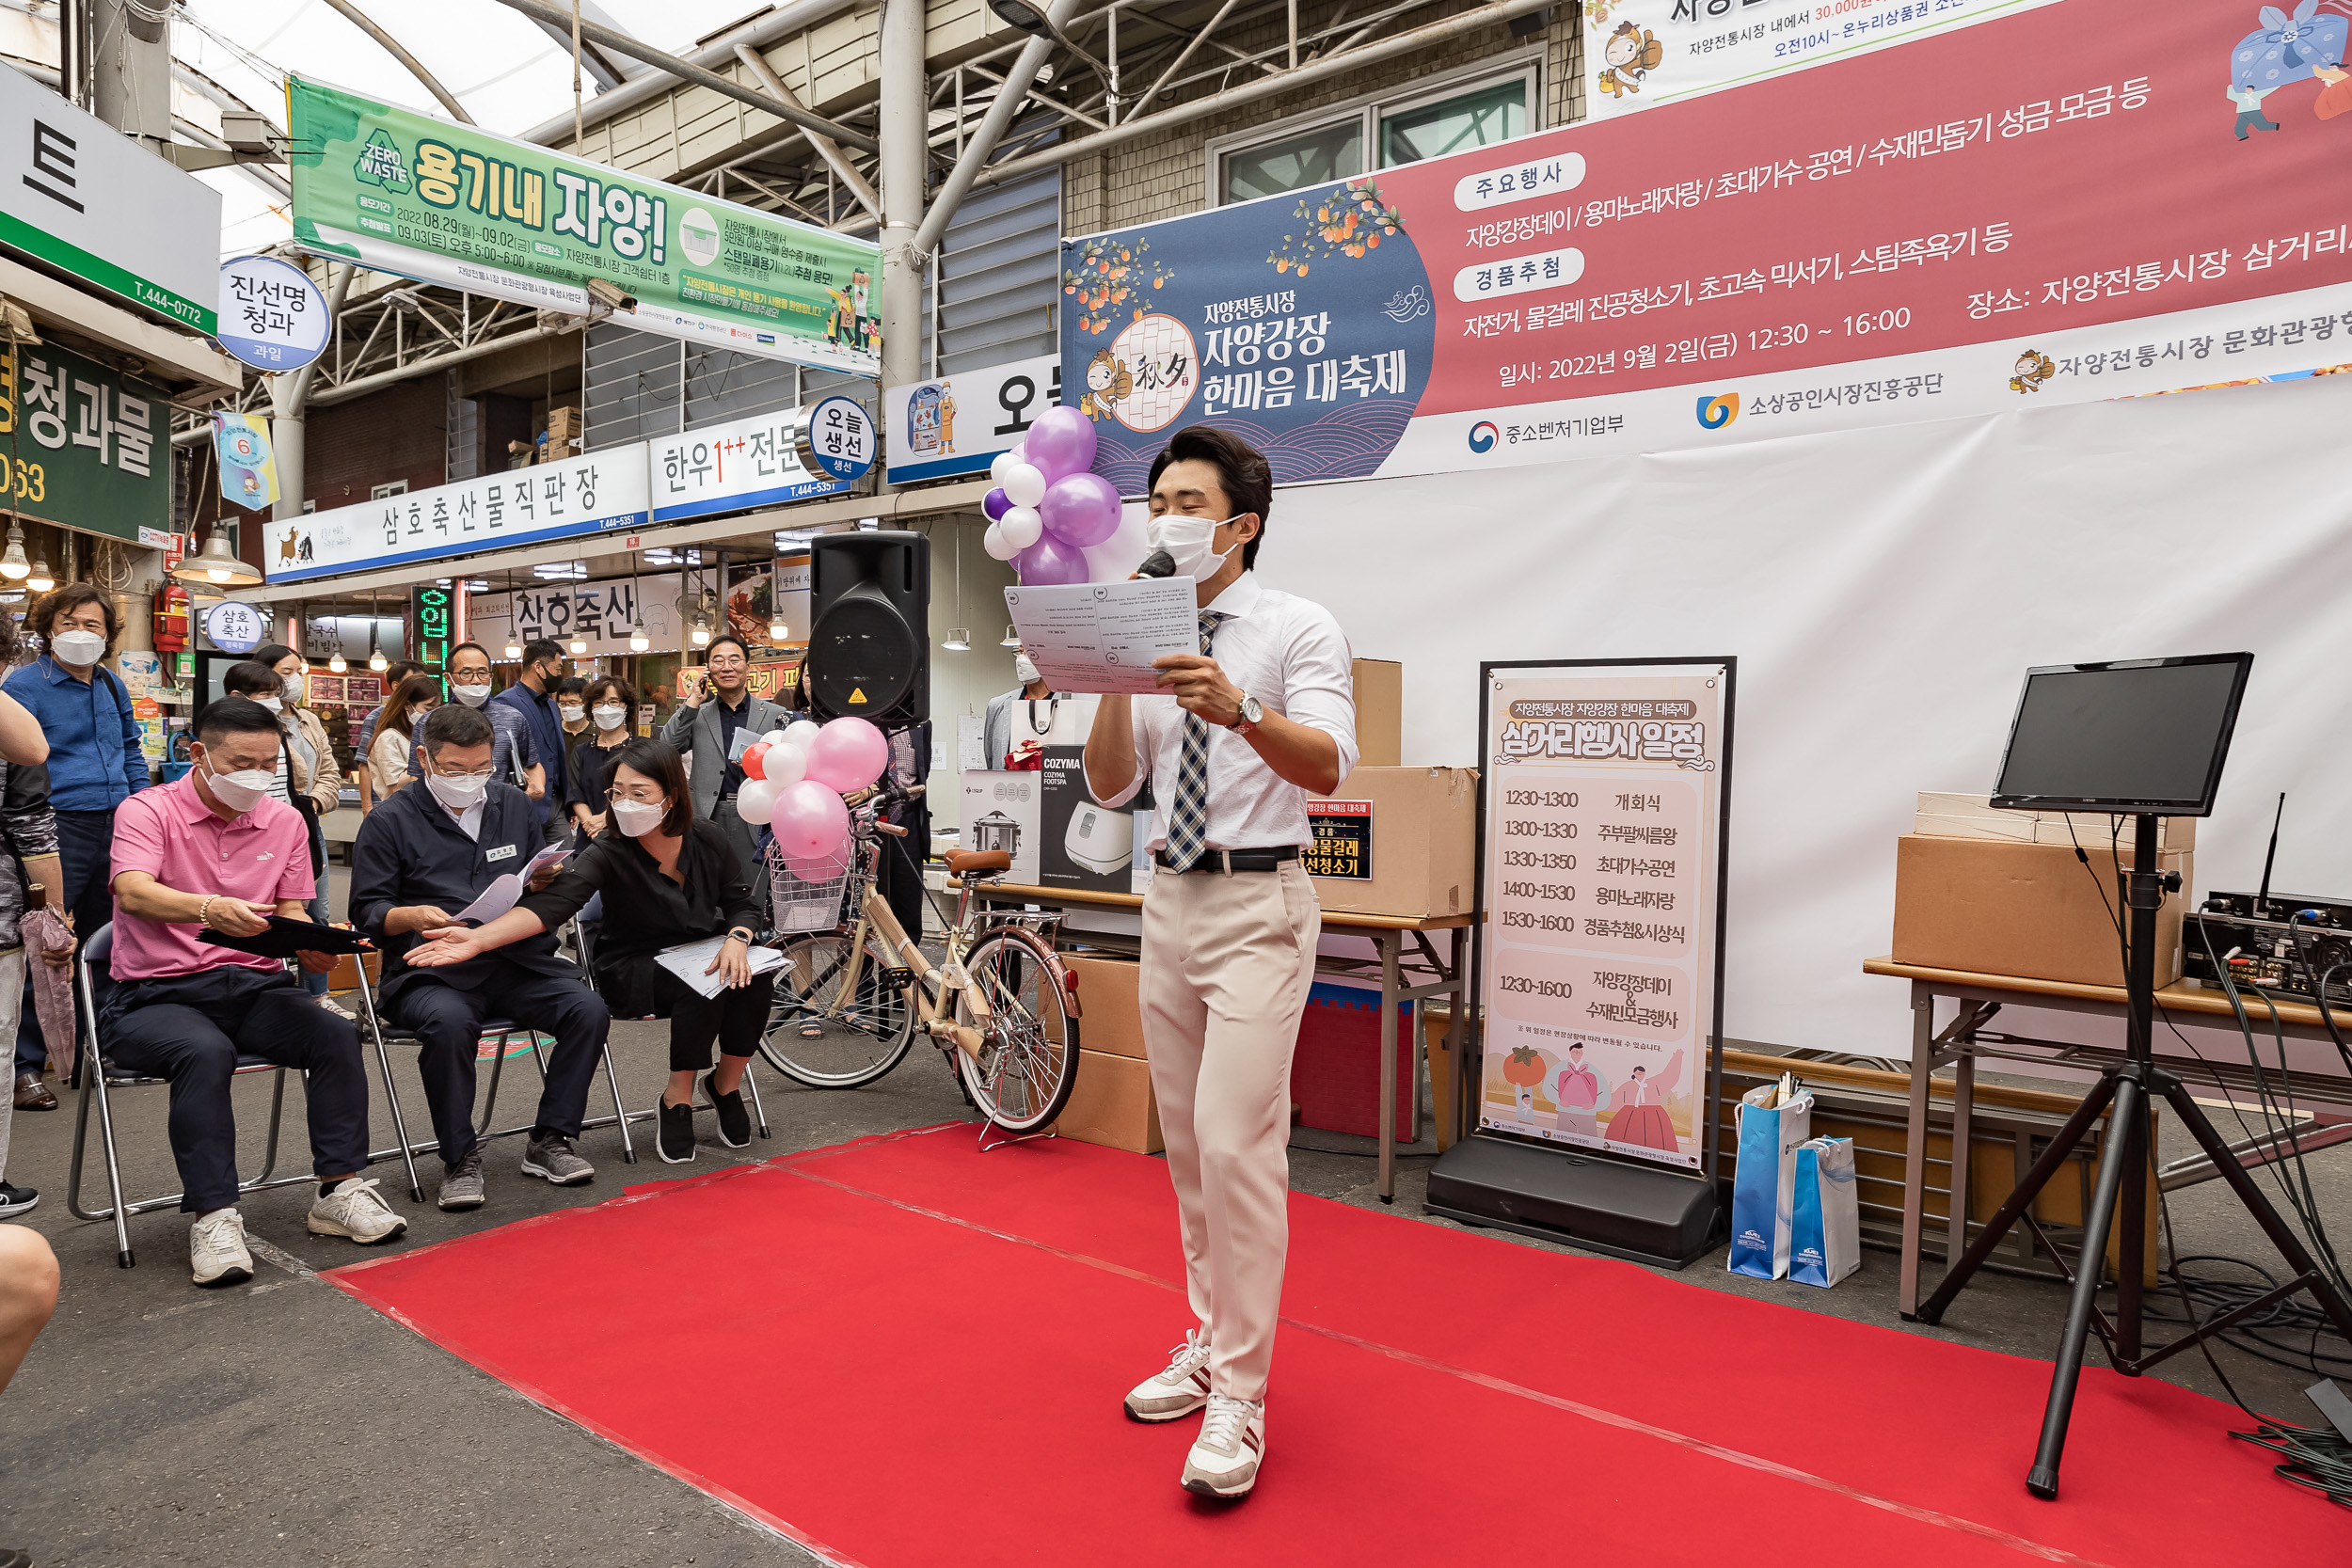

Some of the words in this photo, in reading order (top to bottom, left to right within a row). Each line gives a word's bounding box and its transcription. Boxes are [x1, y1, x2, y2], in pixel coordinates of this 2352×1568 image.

[1689, 24, 1766, 55] 자양전통시장
[1771, 10, 1810, 34] 내에서
[23, 118, 85, 214] 트
[365, 142, 401, 166] ZERO
[1465, 206, 1571, 249] 자양강장데이
[1582, 177, 1703, 228] 용마노래자랑
[1714, 159, 1804, 199] 초대가수
[1805, 144, 1852, 182] 공연
[1867, 112, 1993, 167] 수재민돕기
[1996, 99, 2054, 137] 성금
[2055, 85, 2117, 124] 모금
[2120, 76, 2153, 111] 등
[359, 156, 407, 184] WASTE
[1475, 161, 1563, 199] 주요행사
[359, 196, 391, 214] 응모기간
[415, 142, 543, 228] 용기내
[552, 171, 665, 263] 자양!
[397, 224, 447, 250] 09.03(토)
[450, 237, 472, 256] 오후
[474, 244, 525, 268] 5:00~6:00
[724, 218, 787, 246] 자양전통시장에서
[724, 231, 745, 247] 5만원
[746, 236, 762, 251] 이상
[764, 242, 780, 257] 구매
[781, 245, 803, 262] 영수증
[804, 252, 827, 269] 제출시
[457, 266, 500, 284] 자양전통시장
[565, 248, 621, 273] 자양전통시장
[658, 271, 671, 285] 1층
[741, 266, 755, 279] 추첨
[756, 270, 770, 282] 증정
[1463, 309, 1521, 340] 자전거,
[1525, 297, 1584, 331] 물걸레
[1586, 280, 1692, 321] 진공청소기,
[1697, 268, 1767, 303] 초고속
[1770, 255, 1844, 289] 믹서기,
[1848, 227, 1977, 277] 스팀족욕기
[1981, 221, 2013, 254] 등
[1474, 257, 1561, 292] 경품추첨
[135, 281, 201, 325] T.444-0772
[230, 275, 307, 312] 진선명
[1202, 289, 1296, 325] 자양전통시장
[1499, 360, 1543, 388] 일시:
[1549, 349, 1616, 381] 2022년
[1623, 342, 1658, 372] 9월
[1664, 330, 1739, 363] 2일(금)
[1747, 322, 1809, 352] 12:30
[1842, 305, 1912, 337] 16:00
[1964, 288, 2030, 321] 장소:
[2041, 247, 2231, 307] 자양전통시장
[2242, 224, 2352, 272] 삼거리
[243, 304, 294, 337] 청과
[253, 344, 282, 362] 과일
[1202, 311, 1332, 368] 자양강장
[2058, 334, 2215, 377] 자양전통시장
[1203, 365, 1295, 417] 한마음
[1305, 349, 1406, 404] 대축제
[1749, 372, 1944, 417] 소상공인시장진흥공단
[23, 355, 153, 478] 청과물
[825, 407, 864, 431] 오늘
[1505, 414, 1624, 445] 중소벤처기업부
[237, 438, 251, 454] 6
[824, 432, 863, 458] 생선
[833, 459, 852, 473] 생선
[382, 464, 599, 546] 삼호축산물직판장
[598, 515, 635, 531] T.444-5351
[222, 610, 249, 624] 삼호
[518, 584, 634, 646] 삼호축산
[221, 624, 249, 639] 축산
[1515, 702, 1575, 718] 자양전통시장
[1576, 702, 1618, 718] 자양강장
[1620, 702, 1654, 718] 한마음
[1655, 702, 1690, 718] 대축제
[1043, 758, 1081, 769] COZYMA
[1505, 789, 1580, 808] 12:30~13:00
[1614, 793, 1661, 813] 개회식
[1504, 819, 1578, 839] 13:00~13:30
[1597, 824, 1678, 846] 주부팔씨름왕
[1503, 850, 1577, 870] 13:30~13:50
[1596, 855, 1676, 879] 초대가수공연
[1502, 880, 1576, 901] 14:00~15:30
[1596, 886, 1677, 911] 용마노래자랑
[1502, 911, 1575, 932] 15:30~16:00
[1583, 917, 1686, 944] 경품추첨&시상식
[1500, 974, 1573, 999] 12:30~16:00
[1592, 970, 1672, 996] 자양강장데이
[1585, 1001, 1679, 1029] 수재민모금행사
[1587, 1035, 1600, 1044] 따라
